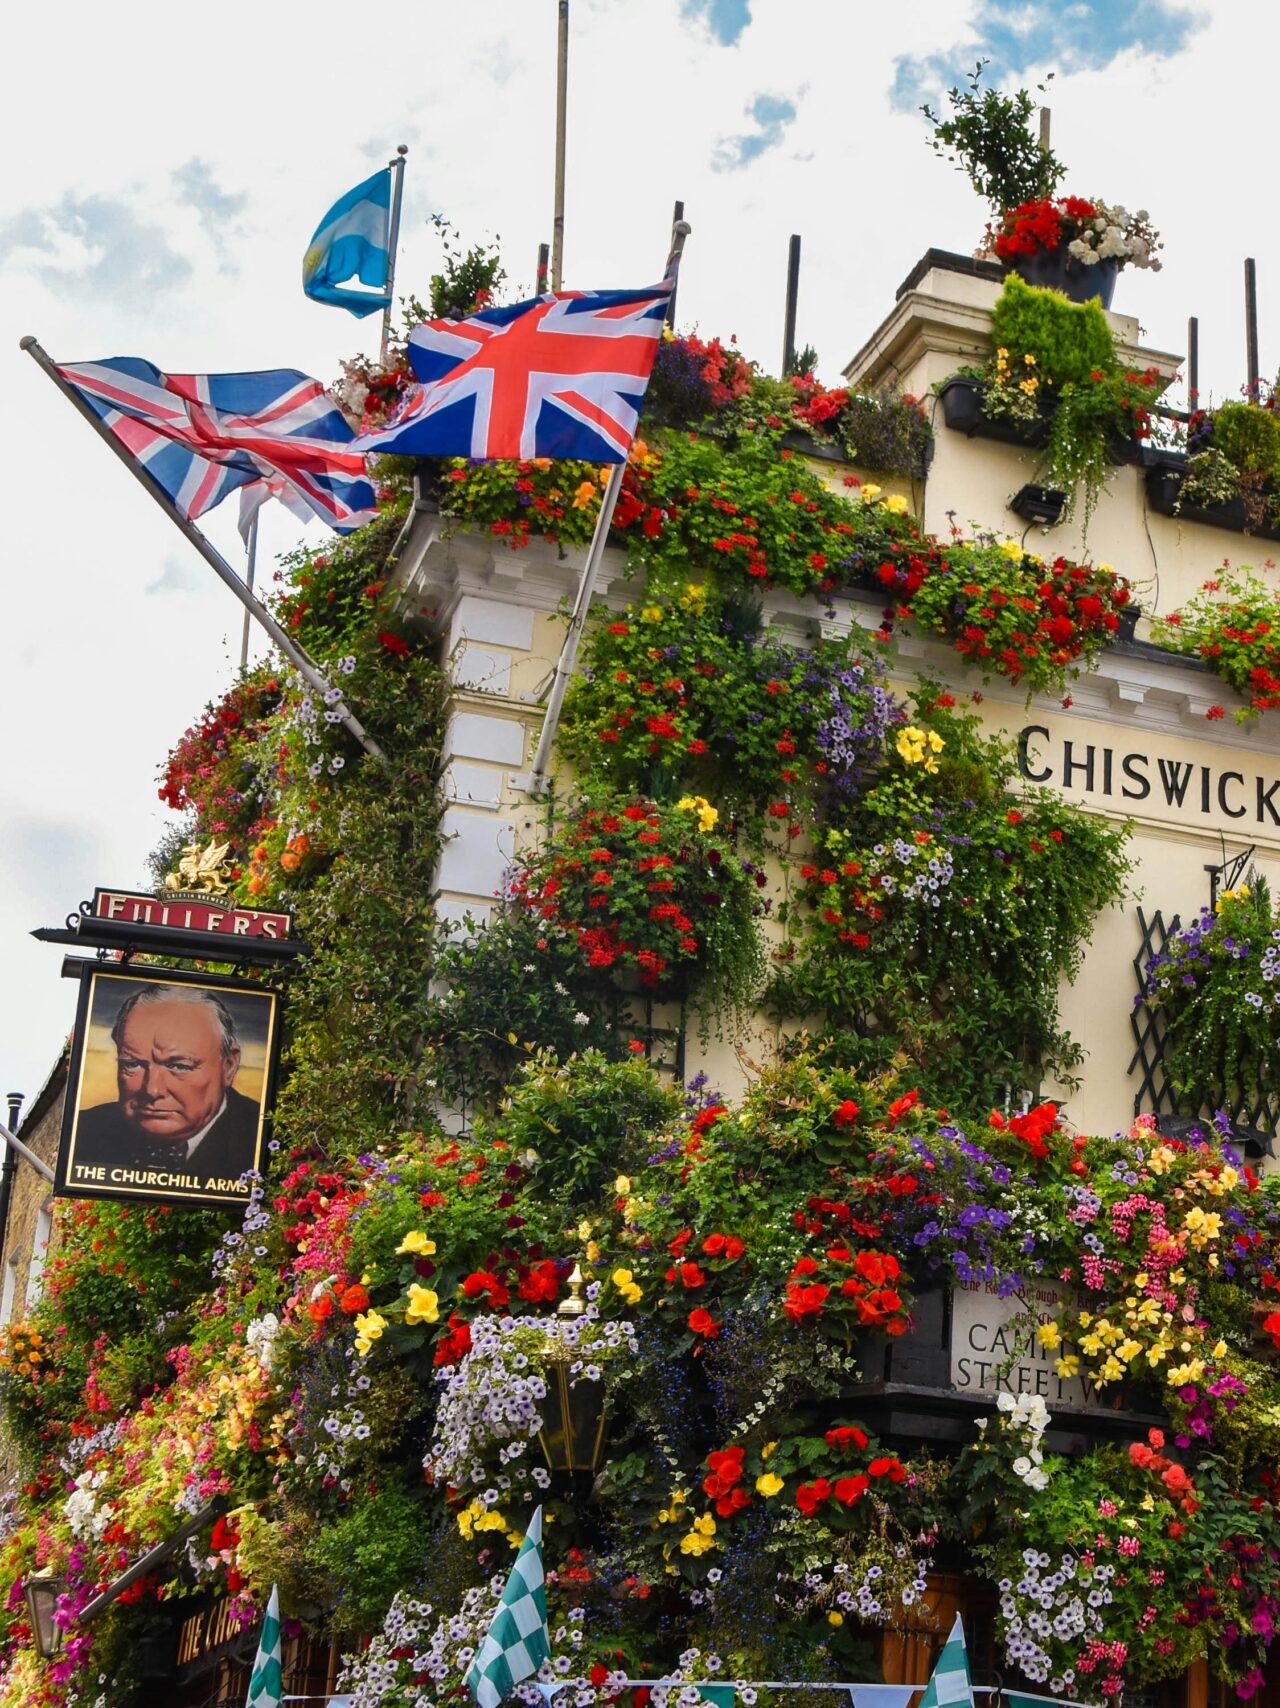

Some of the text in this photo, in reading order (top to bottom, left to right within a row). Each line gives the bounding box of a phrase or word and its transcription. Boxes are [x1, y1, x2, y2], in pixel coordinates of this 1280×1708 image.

[75, 1165, 249, 1193] THE CHURCHILL ARMS
[1018, 1285, 1058, 1306] Boough
